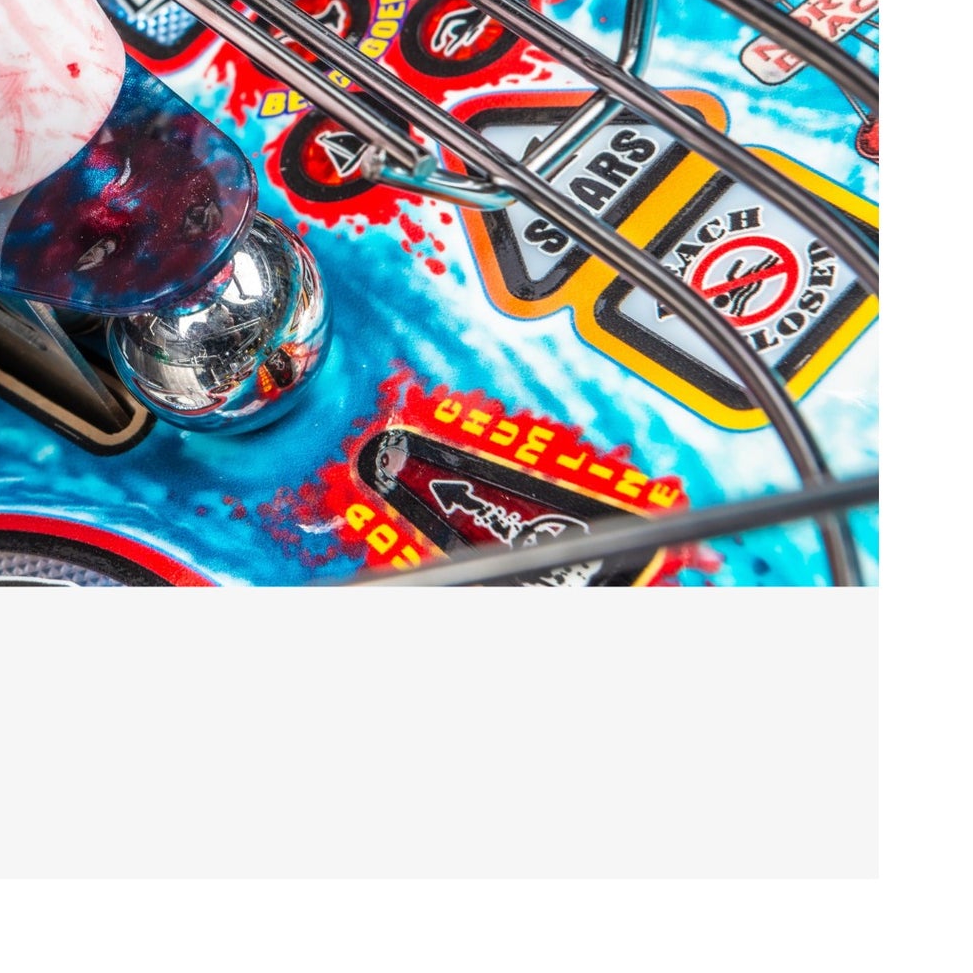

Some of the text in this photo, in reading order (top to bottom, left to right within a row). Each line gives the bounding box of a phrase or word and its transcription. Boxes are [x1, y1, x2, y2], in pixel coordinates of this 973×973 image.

[524, 128, 657, 255] SARS
[656, 207, 760, 319] ACH
[744, 239, 836, 352] LOSED
[433, 398, 680, 509] CHUM LINE
